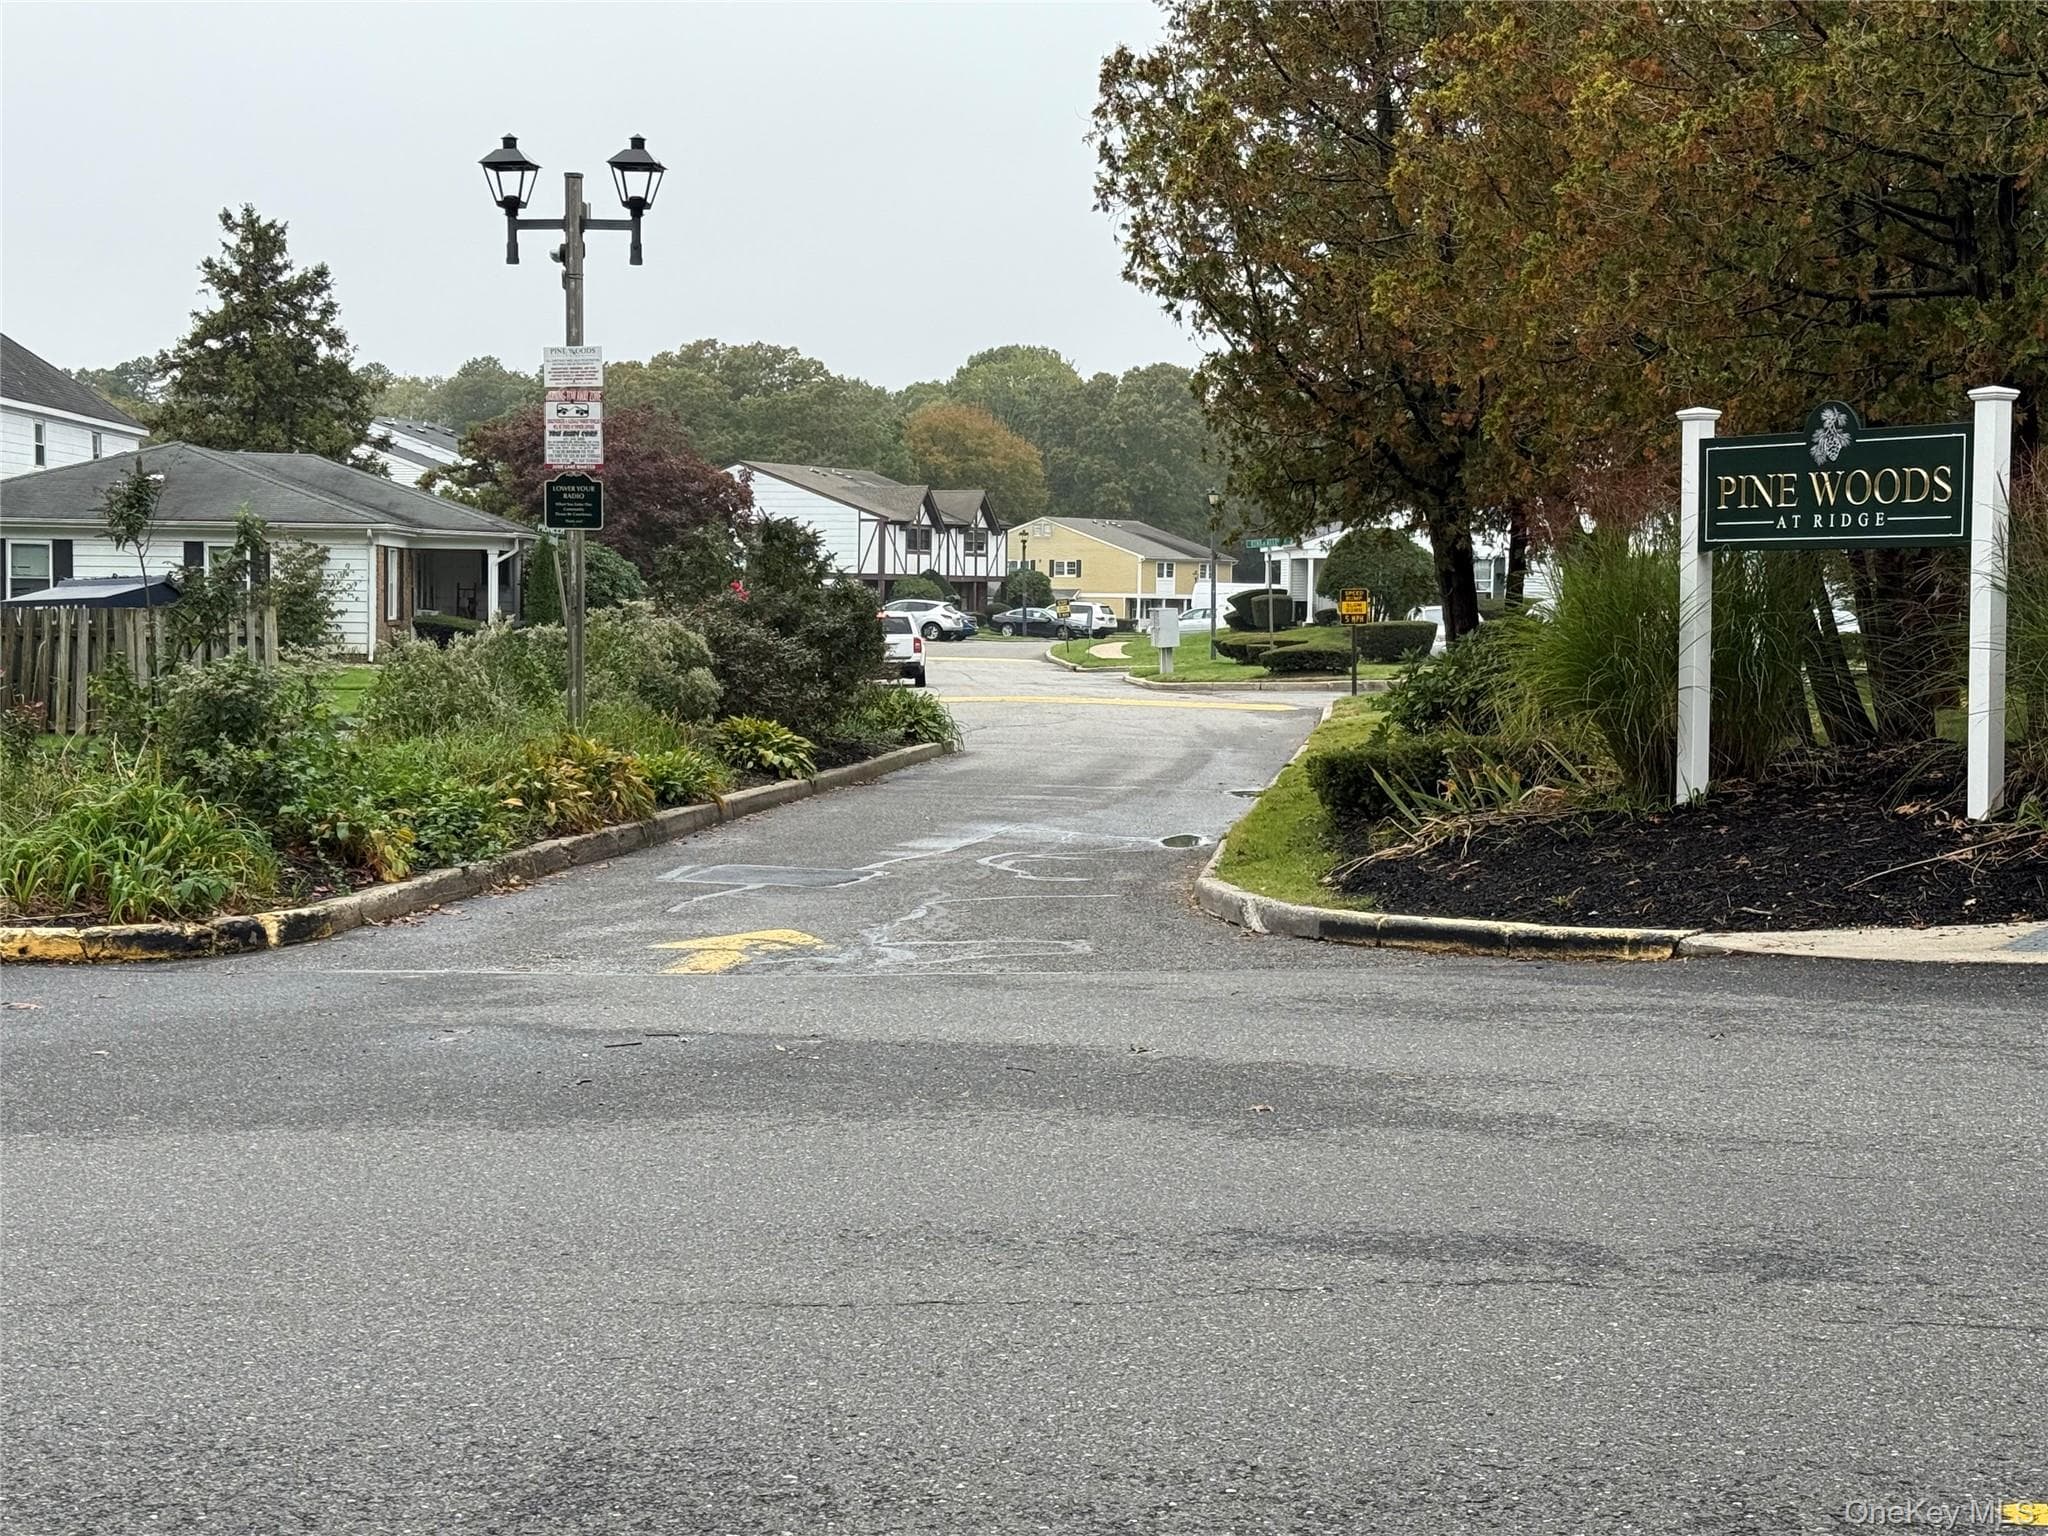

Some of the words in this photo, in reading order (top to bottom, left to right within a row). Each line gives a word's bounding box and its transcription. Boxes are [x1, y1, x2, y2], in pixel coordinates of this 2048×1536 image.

[1716, 473, 1800, 510] PINE
[1808, 465, 1952, 507] WOODS
[1776, 514, 1802, 529] AT
[1813, 512, 1886, 529] RIDGE
